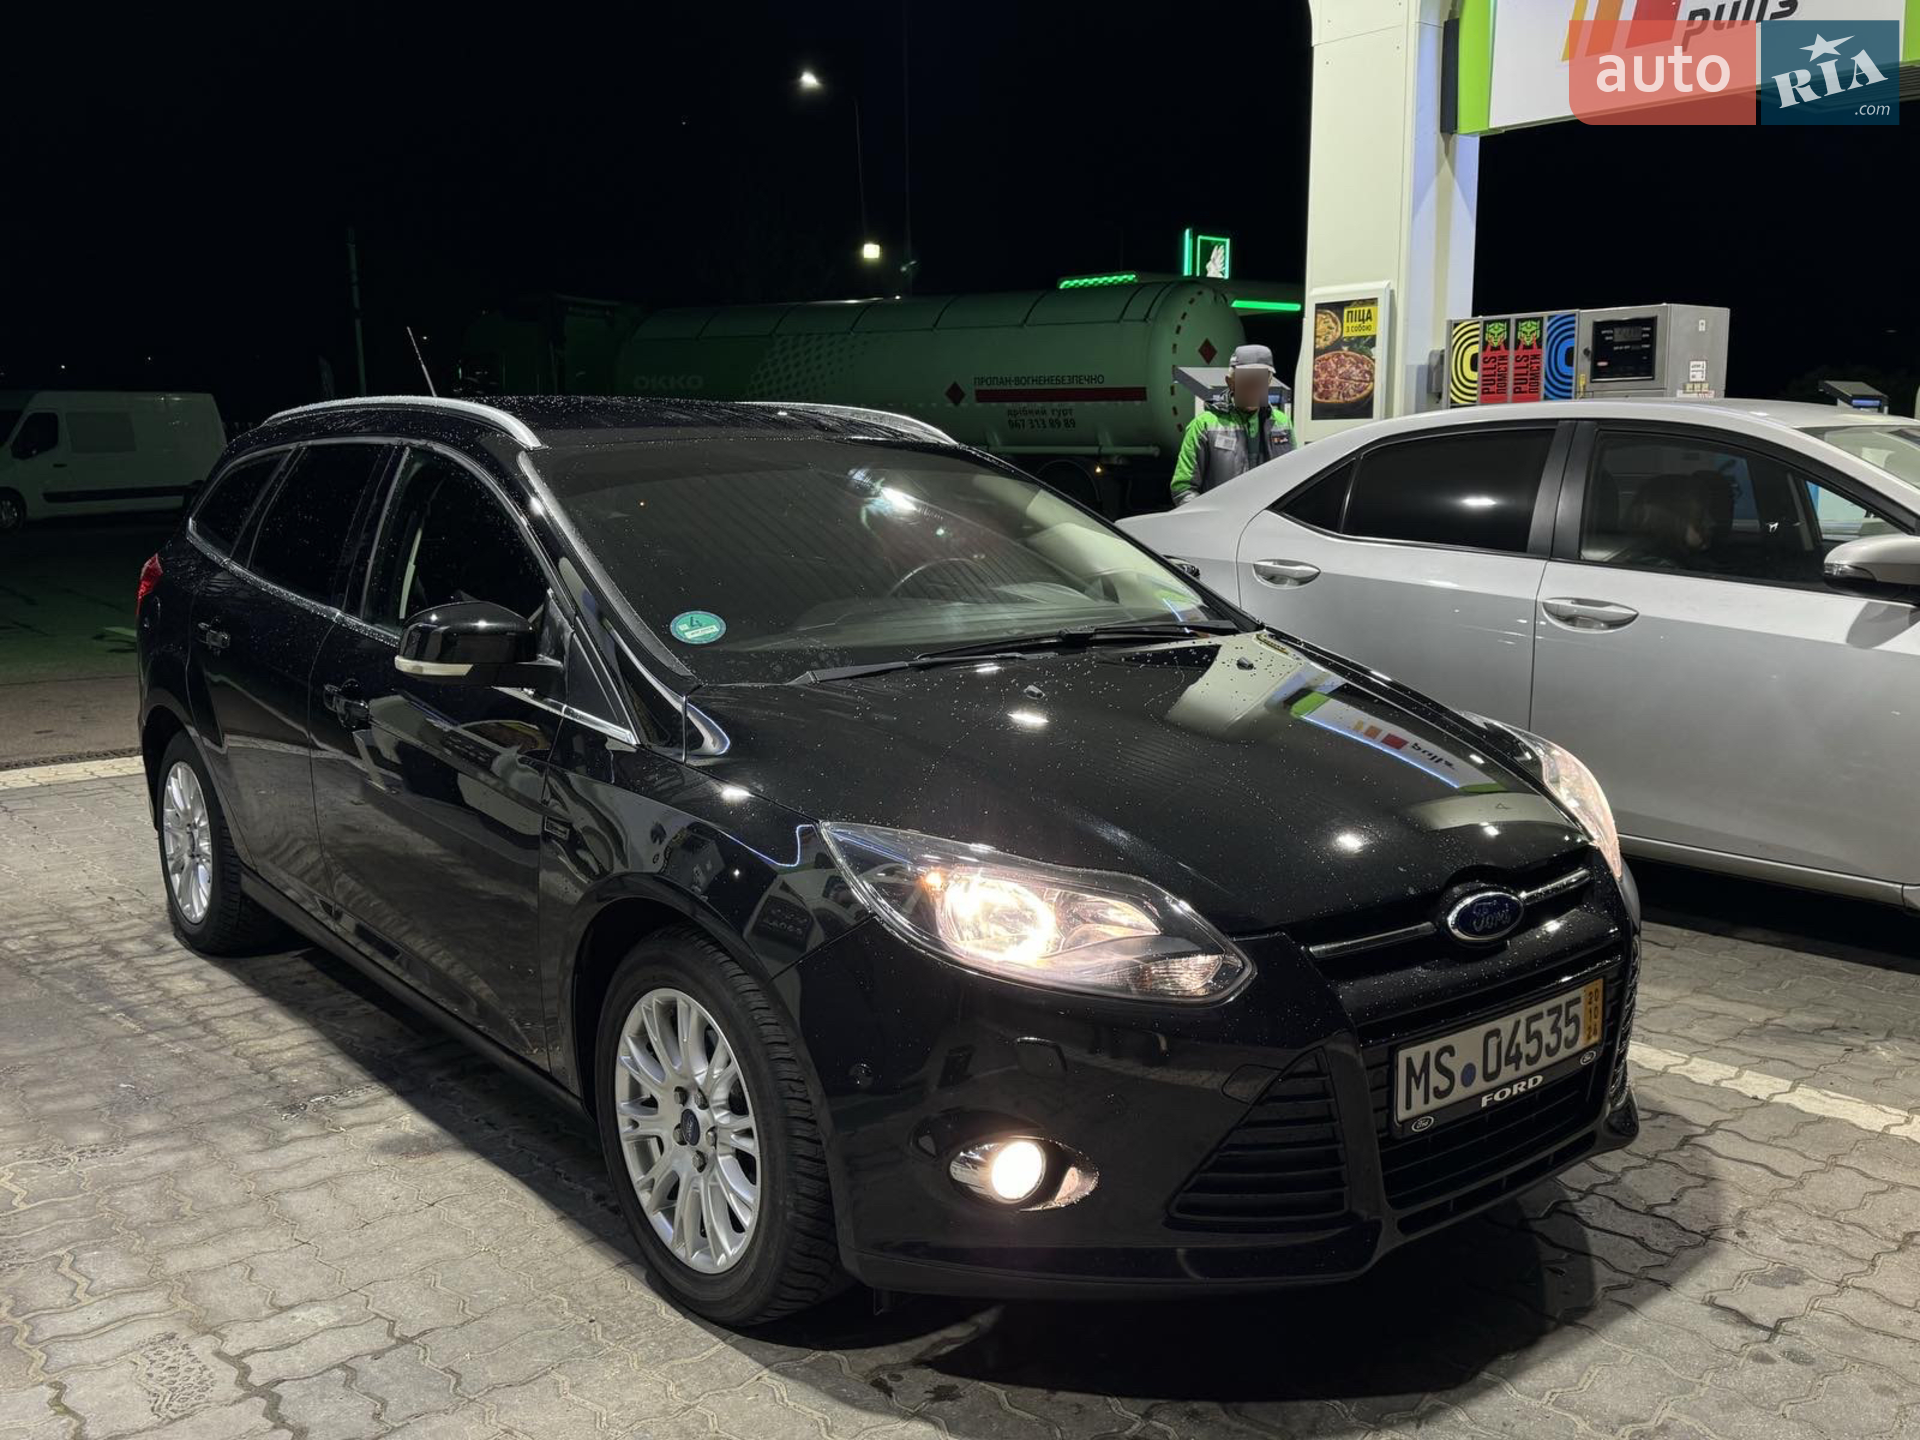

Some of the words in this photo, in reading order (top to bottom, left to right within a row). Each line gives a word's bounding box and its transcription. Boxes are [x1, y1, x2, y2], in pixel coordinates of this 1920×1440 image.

[1346, 308, 1373, 324] ПІЦА
[973, 374, 1105, 386] ПРОПАН-ВОГНЕНЕБЕЗПЕЧНО
[1481, 355, 1497, 395] PULLS
[1513, 354, 1529, 395] PULLS
[1405, 1046, 1456, 1111] MS
[1482, 997, 1582, 1083] 04535
[1481, 1074, 1544, 1107] FORD
